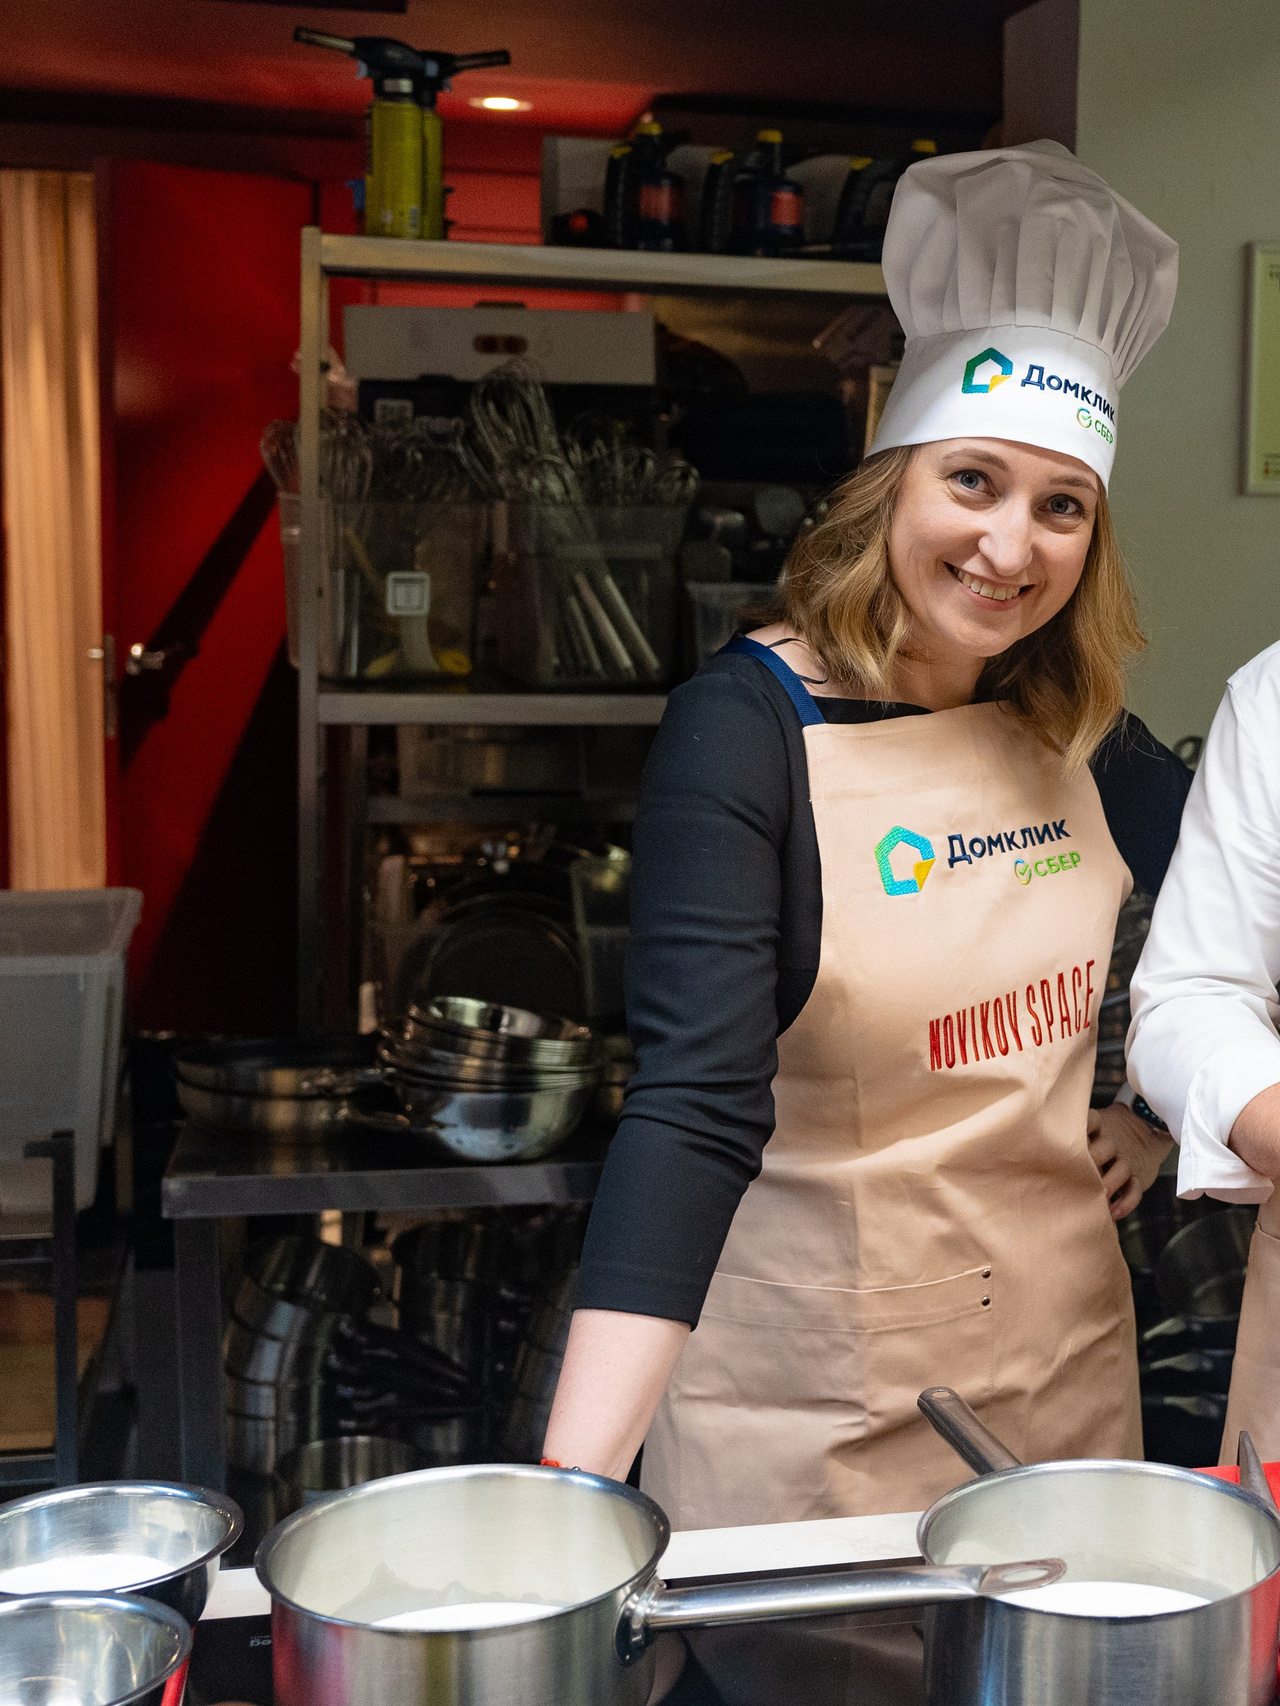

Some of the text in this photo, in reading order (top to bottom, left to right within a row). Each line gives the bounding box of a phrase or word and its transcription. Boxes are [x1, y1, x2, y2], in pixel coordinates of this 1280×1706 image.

[1094, 419, 1114, 446] СБЕР
[1034, 851, 1081, 877] СБЕР
[929, 959, 1095, 1071] NOVIKOV SPACE
